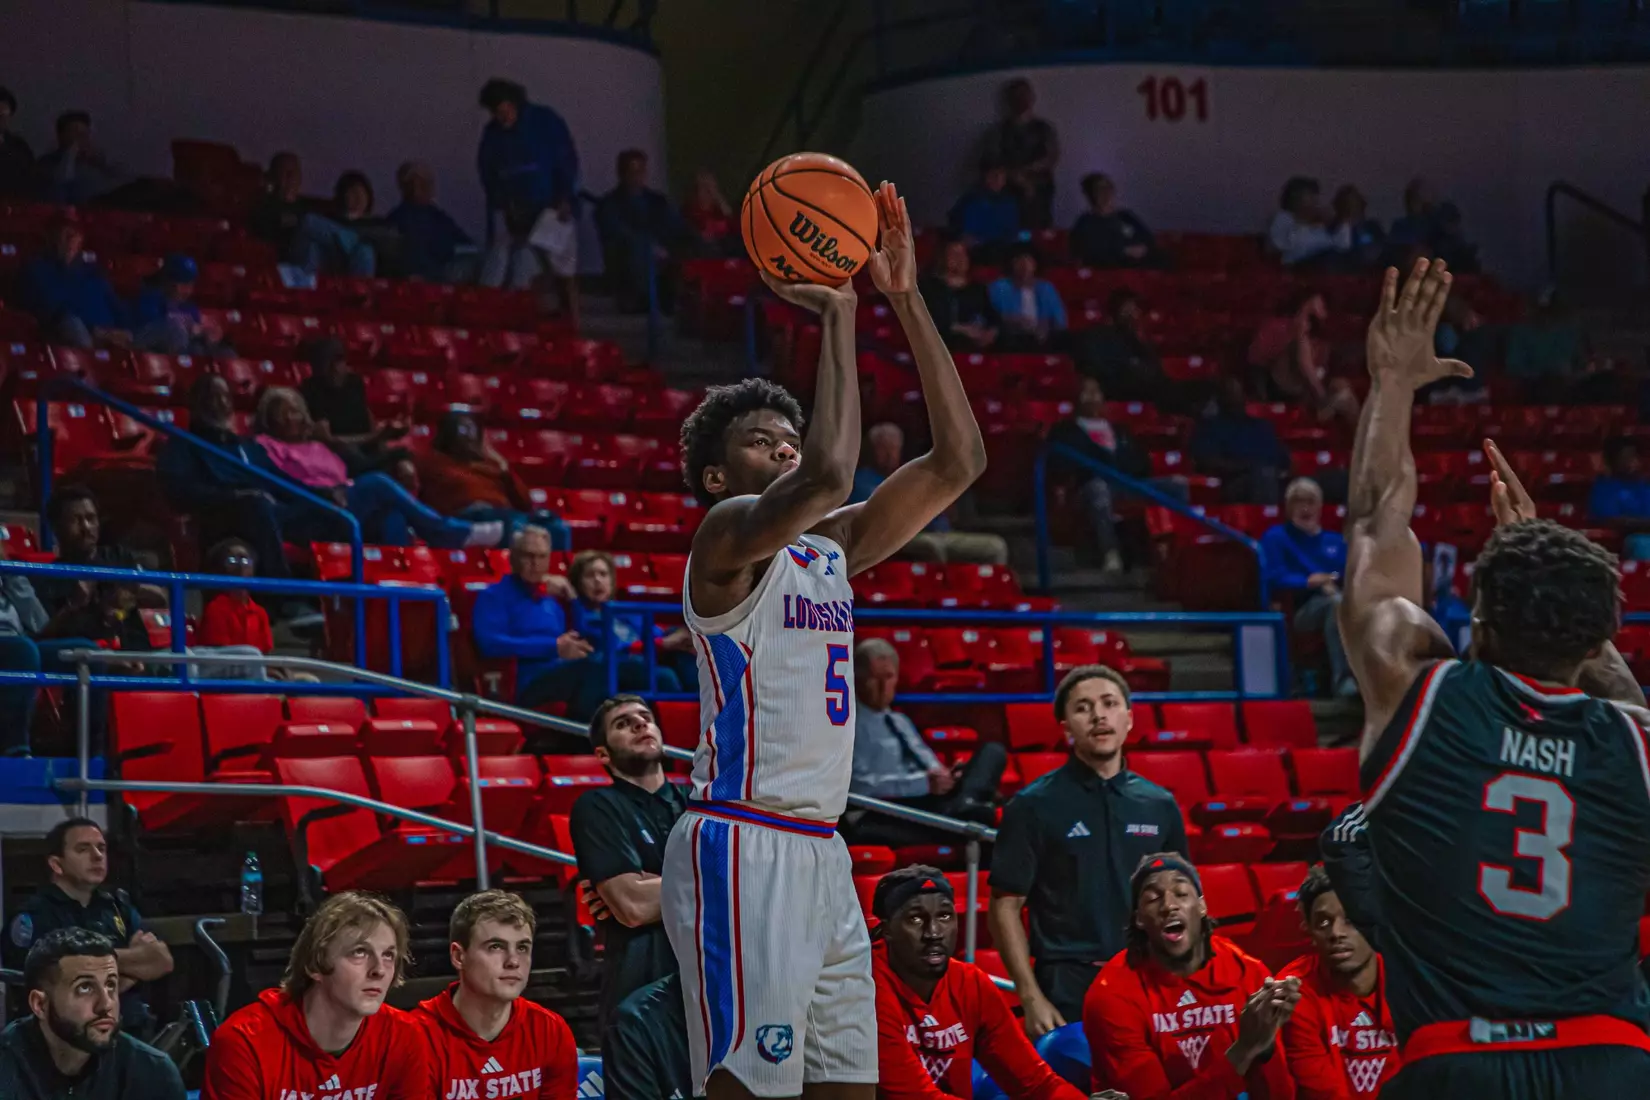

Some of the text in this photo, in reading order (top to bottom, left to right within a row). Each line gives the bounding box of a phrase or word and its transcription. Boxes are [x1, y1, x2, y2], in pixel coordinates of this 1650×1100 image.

[1137, 75, 1208, 122] 101
[790, 211, 858, 273] Wilson
[825, 644, 850, 726] 5
[1500, 727, 1576, 777] NASH
[1477, 770, 1576, 923] 3
[924, 1022, 970, 1050] STATE
[1182, 1004, 1235, 1028] STATE
[446, 1067, 542, 1100] JAX STATE
